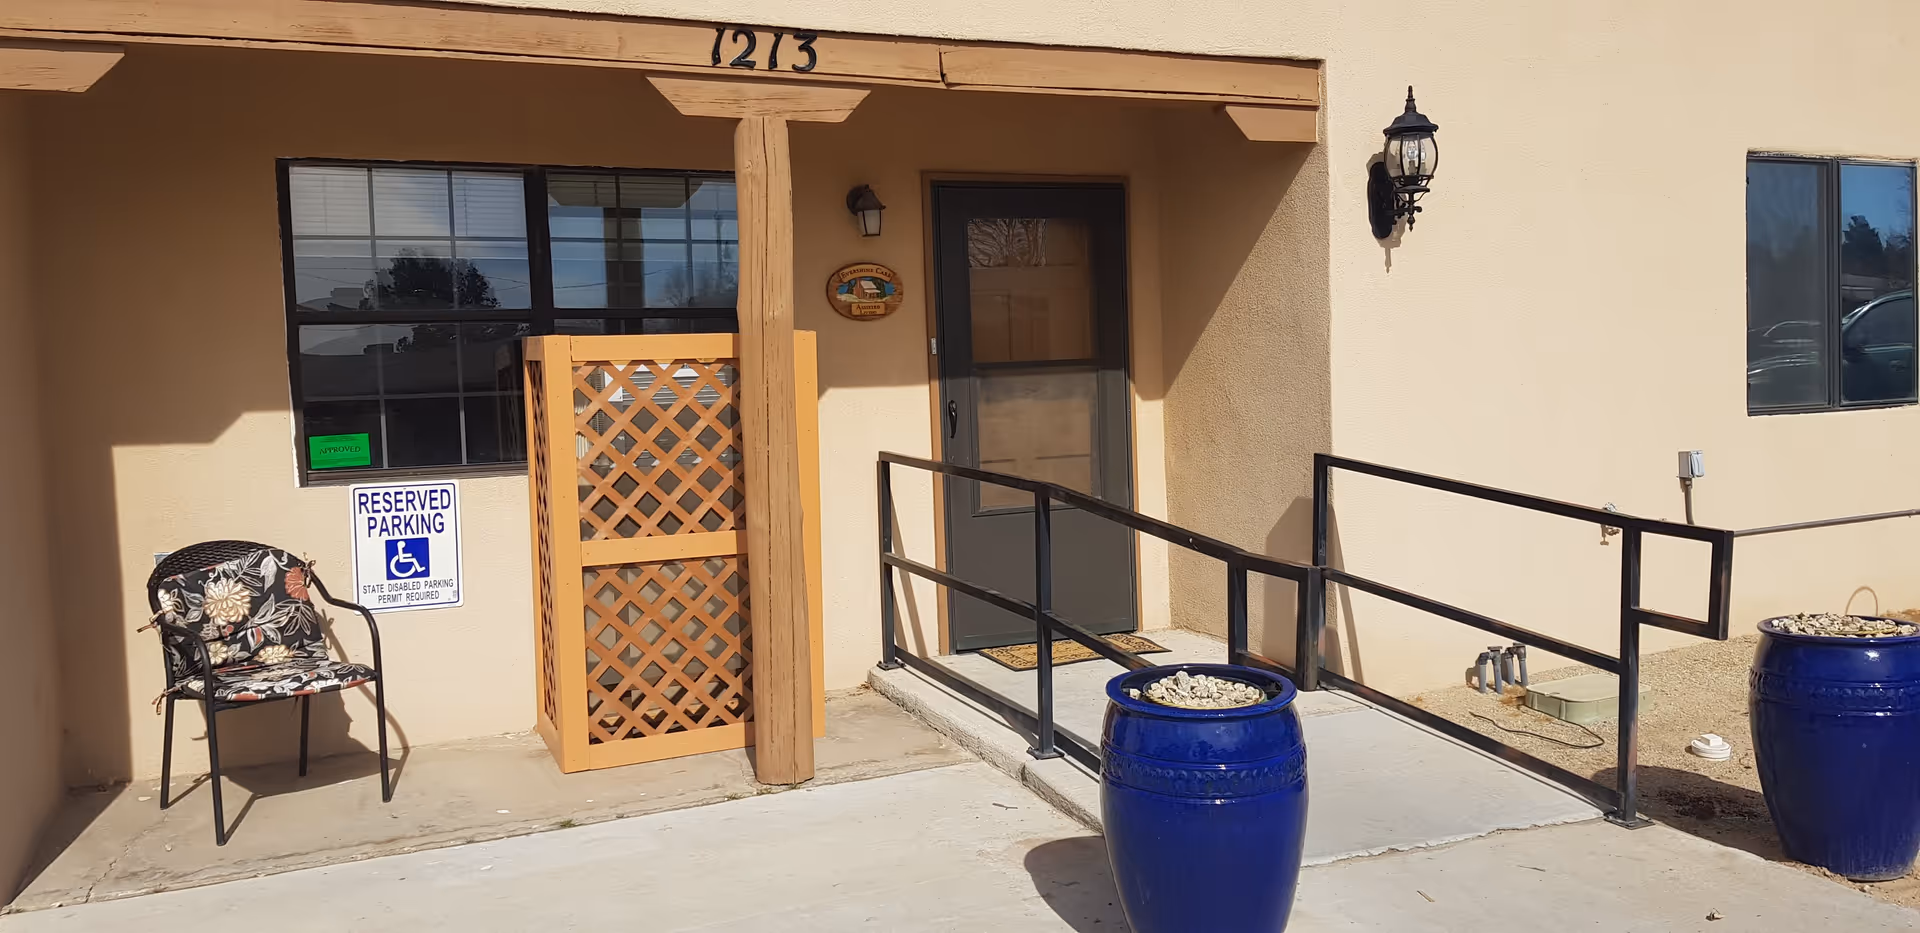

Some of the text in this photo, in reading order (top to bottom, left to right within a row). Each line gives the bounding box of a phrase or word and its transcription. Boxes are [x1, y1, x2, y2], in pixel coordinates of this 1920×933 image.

[712, 27, 817, 71] 1213
[319, 445, 361, 455] APPROVED
[358, 488, 451, 514] RESERVED
[367, 512, 445, 538] PARKING
[362, 578, 454, 594] STATE DISABLED PARKING
[378, 593, 403, 604] PERMIT
[405, 590, 440, 602] REQUIRED
